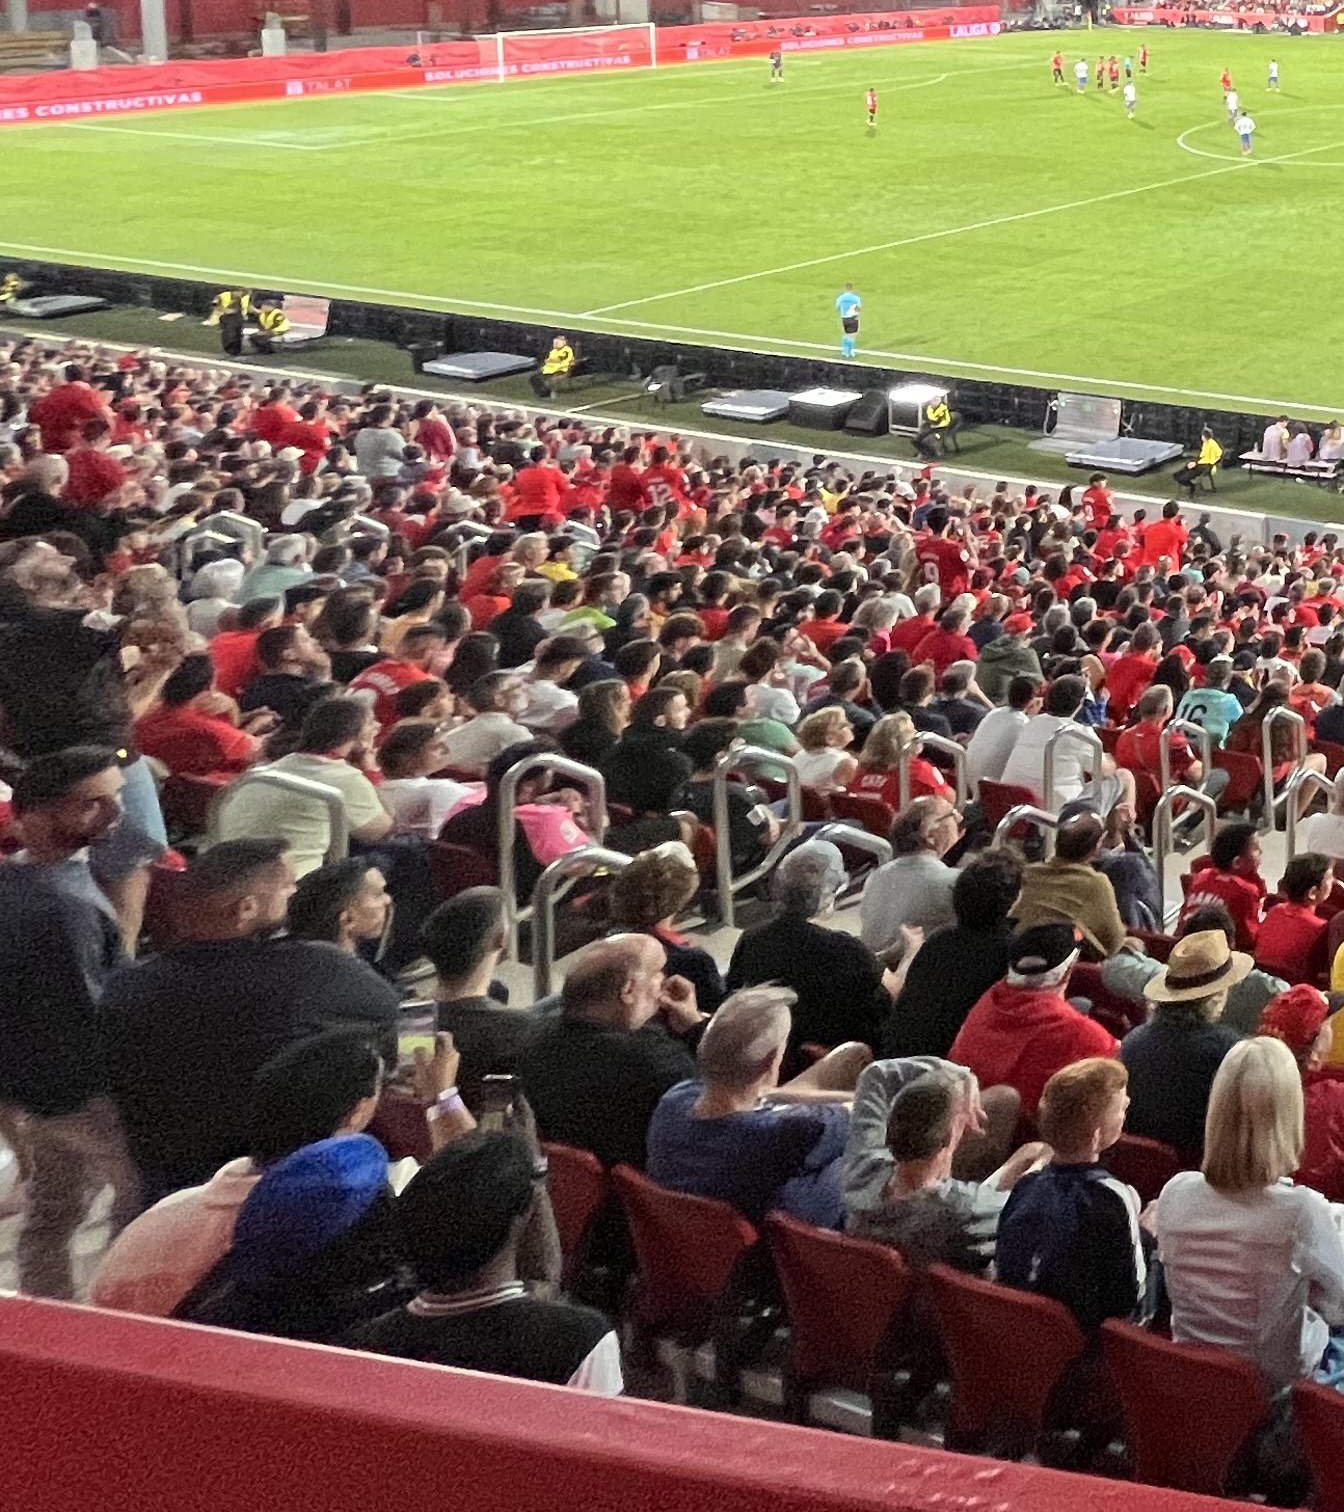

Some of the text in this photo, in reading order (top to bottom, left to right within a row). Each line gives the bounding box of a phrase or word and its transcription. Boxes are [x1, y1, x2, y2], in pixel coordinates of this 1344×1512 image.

[949, 24, 988, 37] LALIGA
[521, 55, 632, 73] CONSTRUCTIVAS
[35, 91, 203, 117] CONSTRUCTIVAS
